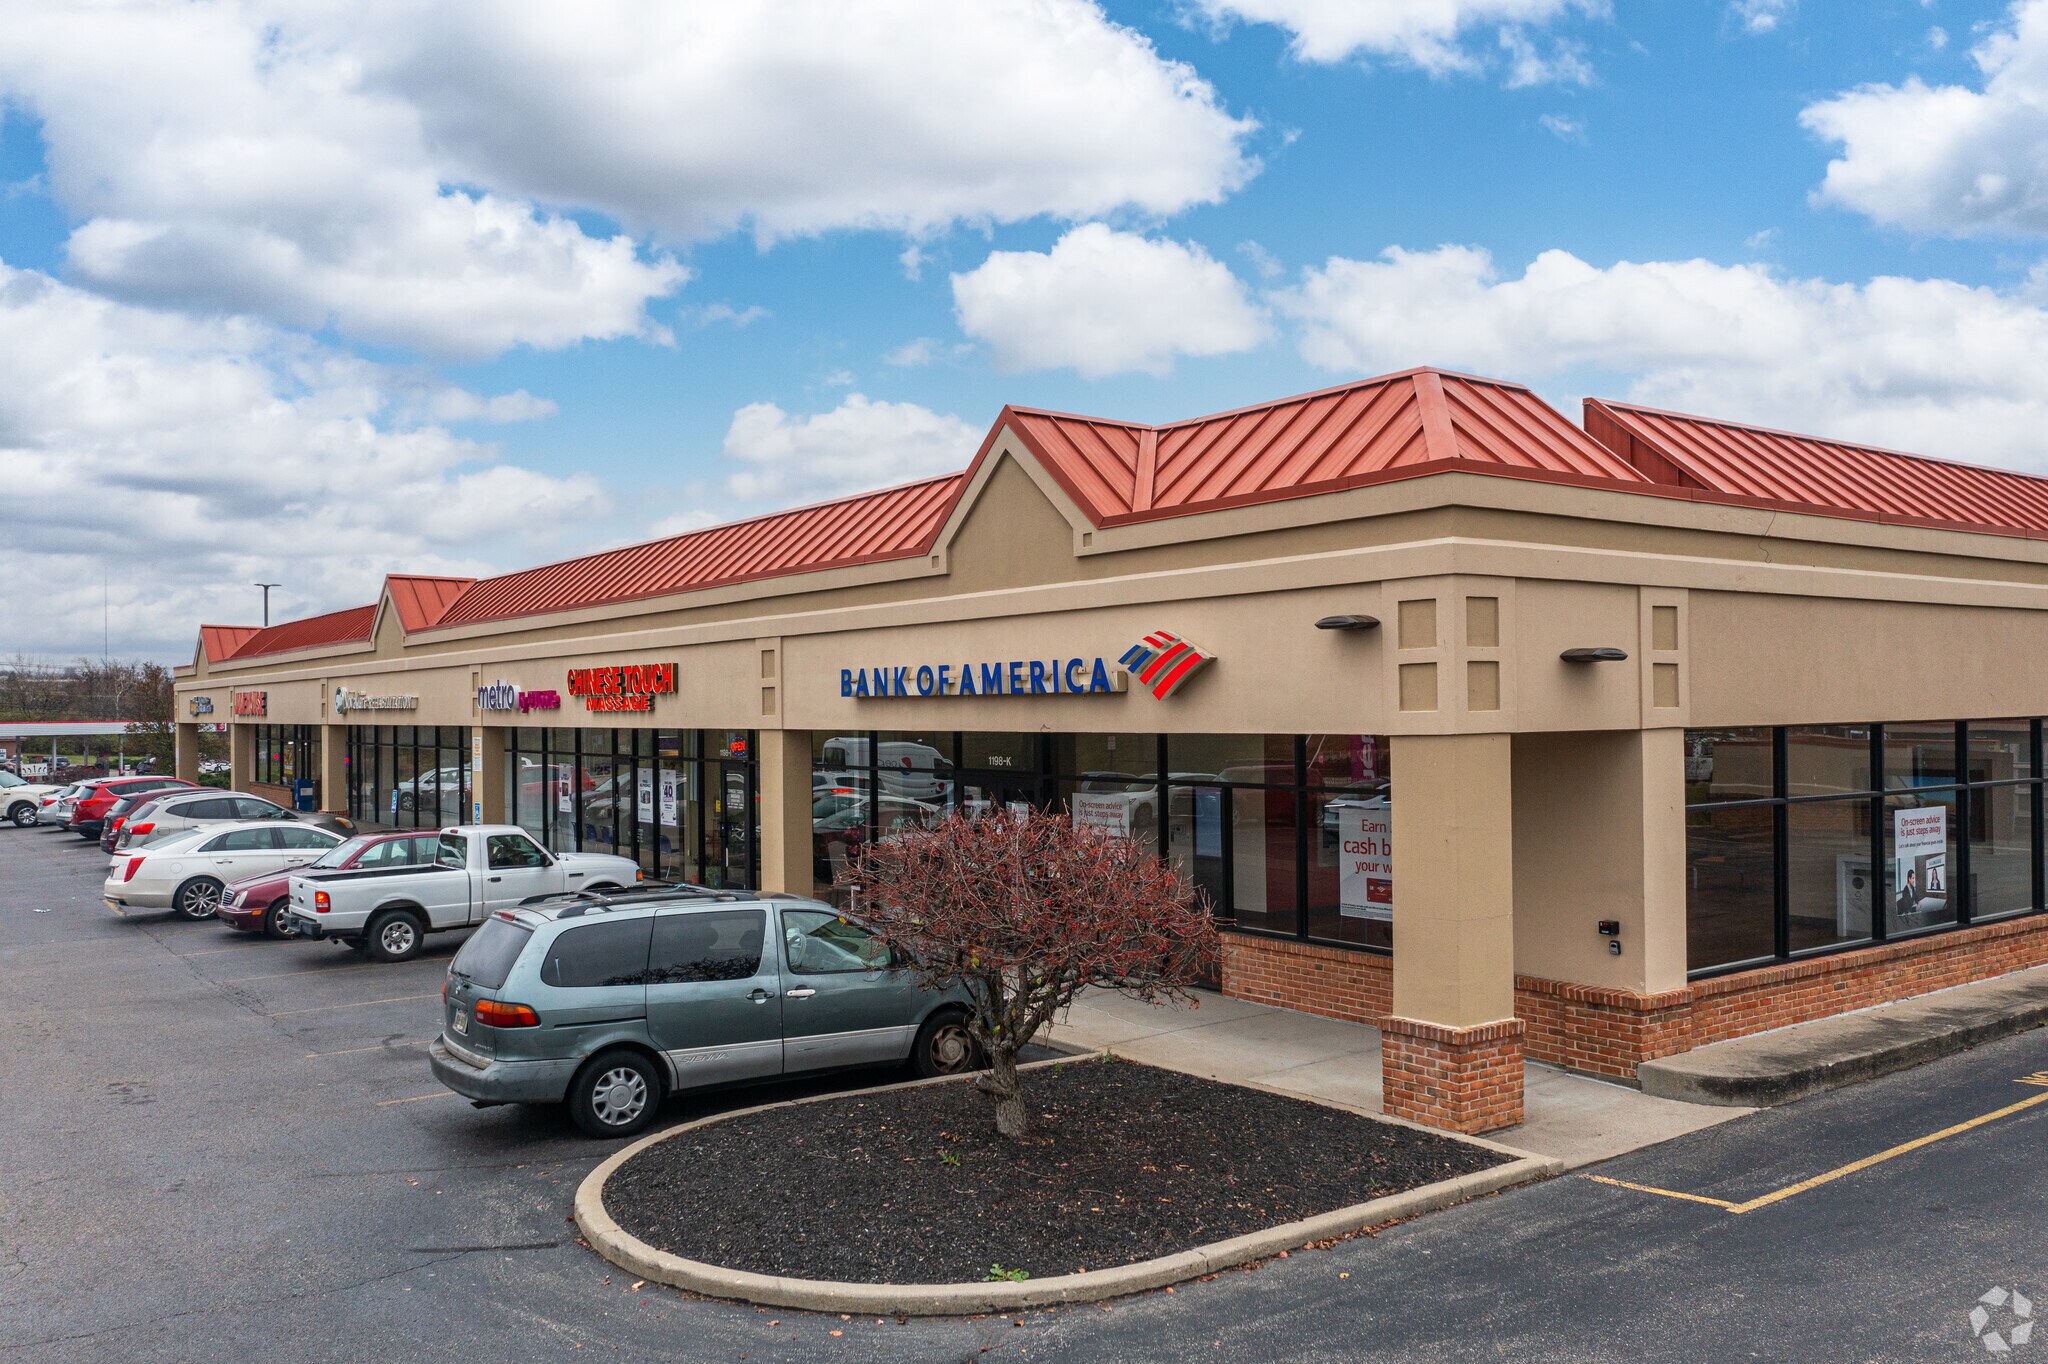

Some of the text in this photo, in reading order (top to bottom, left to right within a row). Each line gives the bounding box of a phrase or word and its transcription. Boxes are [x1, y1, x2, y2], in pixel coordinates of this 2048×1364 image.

[567, 663, 674, 696] CHINESE TOUCH
[841, 658, 1111, 697] BANK OF AMERICA
[478, 680, 515, 709] metro
[586, 695, 650, 711] MASSAGE
[730, 741, 746, 752] OPEN
[988, 756, 1012, 766] 1198-K
[1106, 802, 1123, 810] advice
[1361, 819, 1387, 833] Earn
[1901, 818, 1925, 826] On-screen
[1901, 826, 1941, 838] is just steps away
[1344, 837, 1377, 856] cash
[1355, 861, 1380, 874] your
